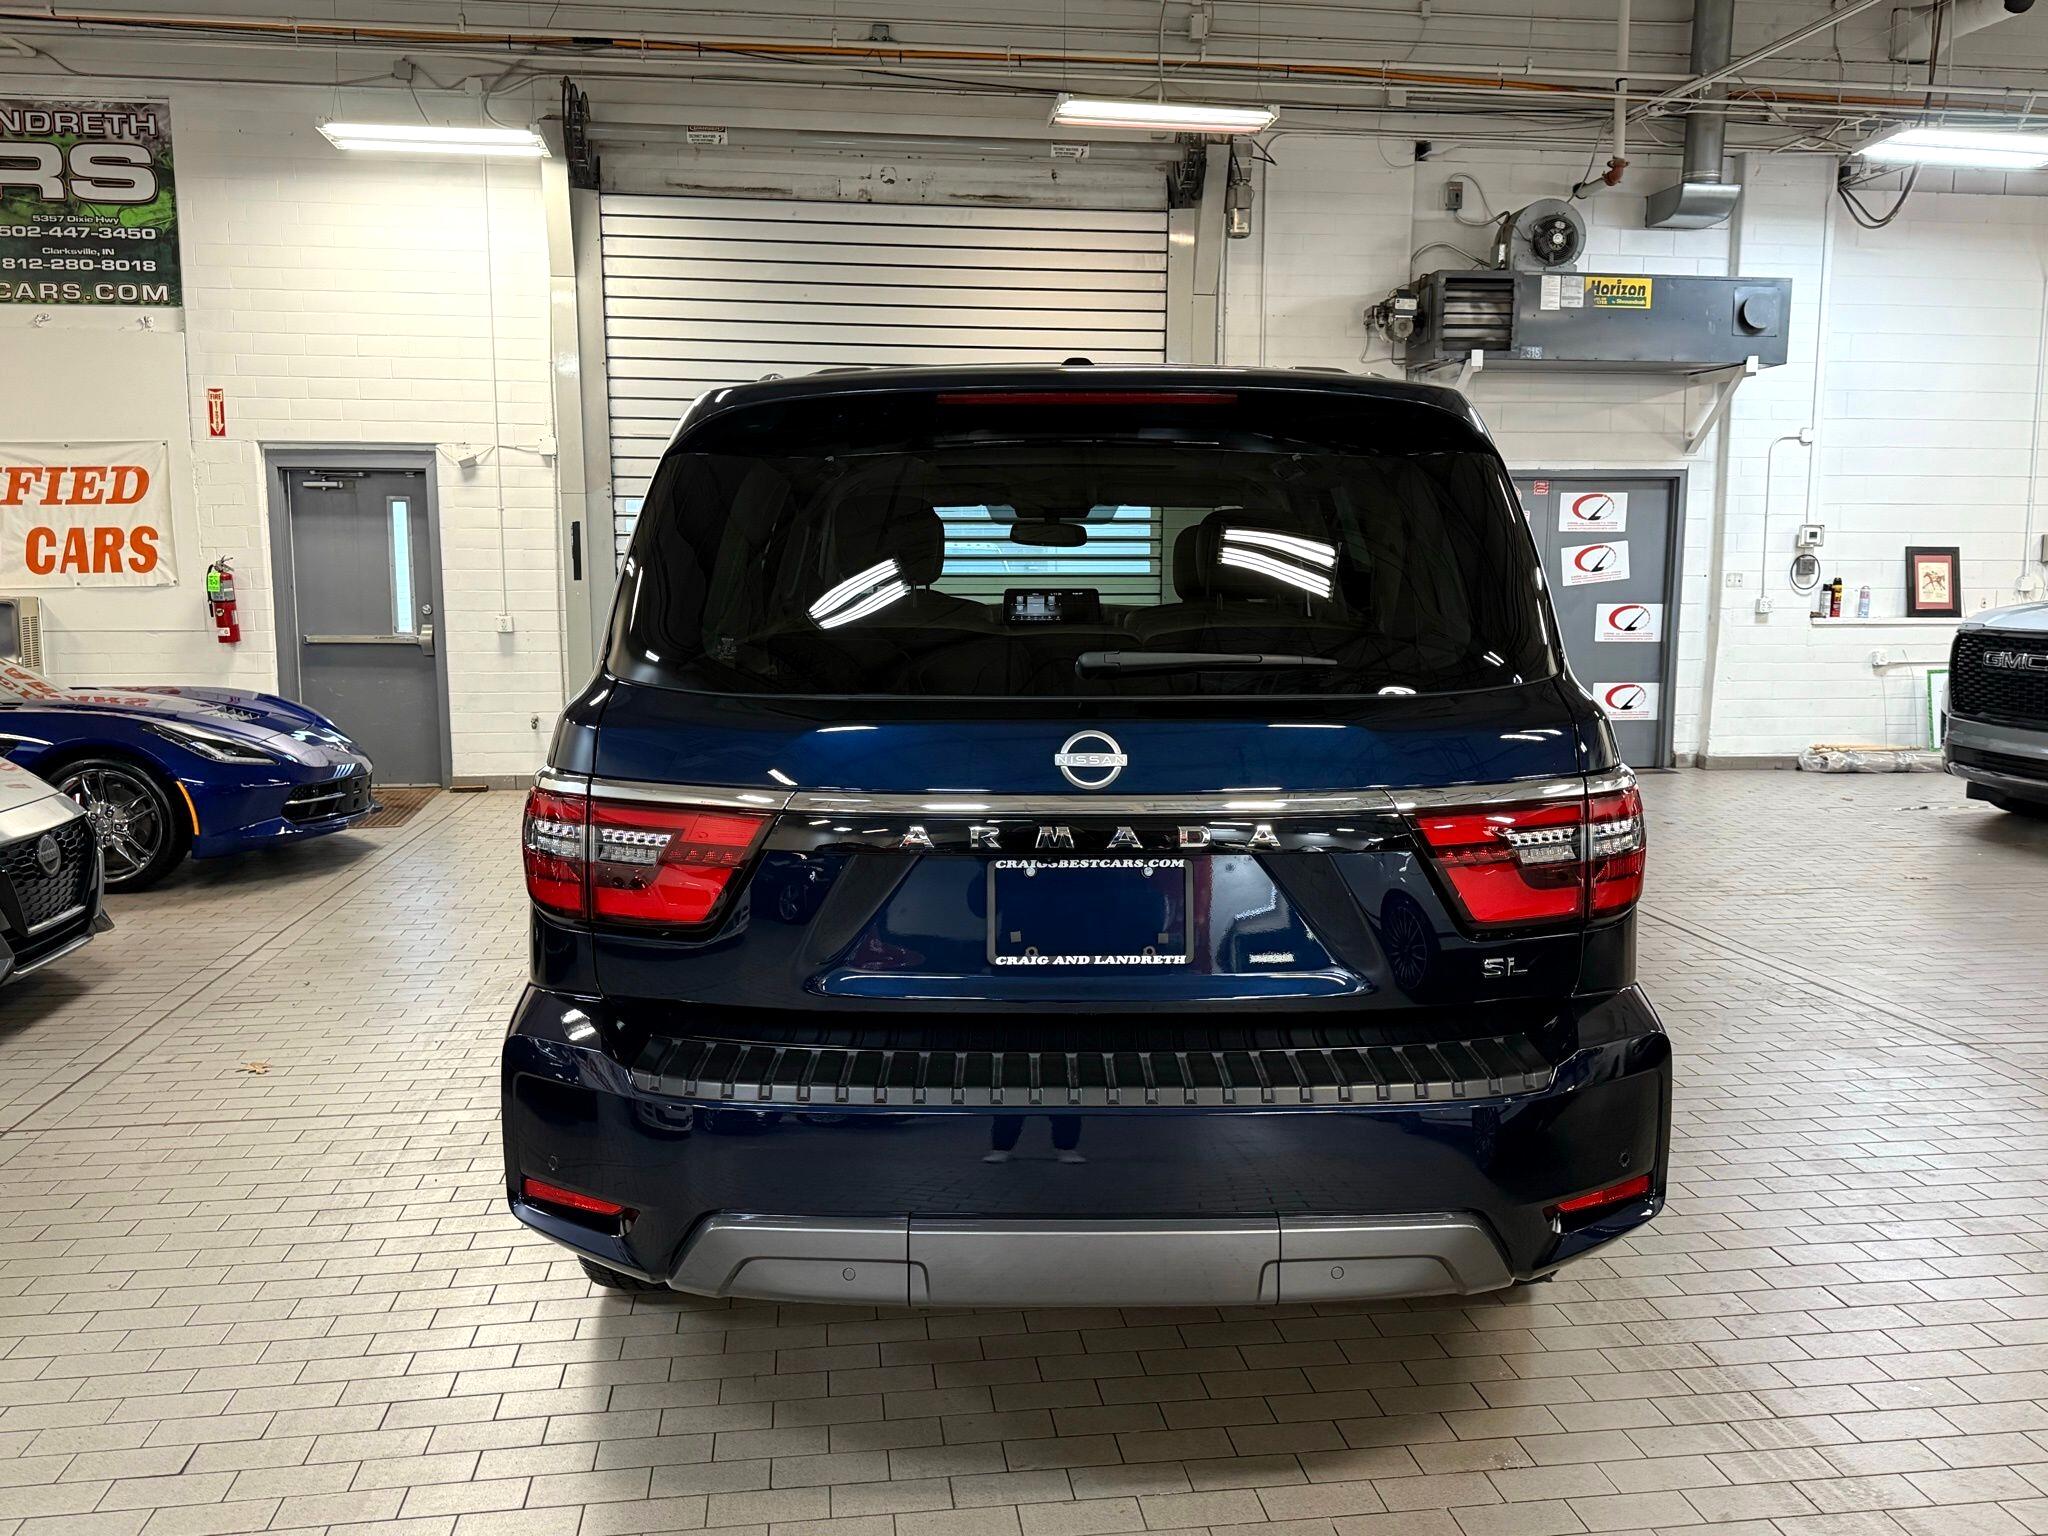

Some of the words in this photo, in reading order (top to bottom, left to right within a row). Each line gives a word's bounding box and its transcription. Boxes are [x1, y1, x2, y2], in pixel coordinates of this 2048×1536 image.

[0, 109, 157, 137] NDRETH
[32, 214, 64, 223] 5357
[66, 215, 94, 223] Dixie
[95, 216, 120, 225] Hwy
[41, 246, 101, 257] Clarksville,
[102, 248, 115, 256] IN
[2, 257, 157, 272] 812-280-8018
[1592, 279, 1646, 297] Horizon
[0, 465, 150, 506] FIED
[25, 525, 159, 575] CARS
[1983, 650, 2048, 671] GMC
[1056, 754, 1126, 766] NISSAN
[899, 825, 1282, 850] ARMADA
[995, 955, 1050, 966] CRAIG
[1052, 955, 1091, 966] AND
[1093, 954, 1187, 965] LANDRETH
[1482, 957, 1528, 978] SL
